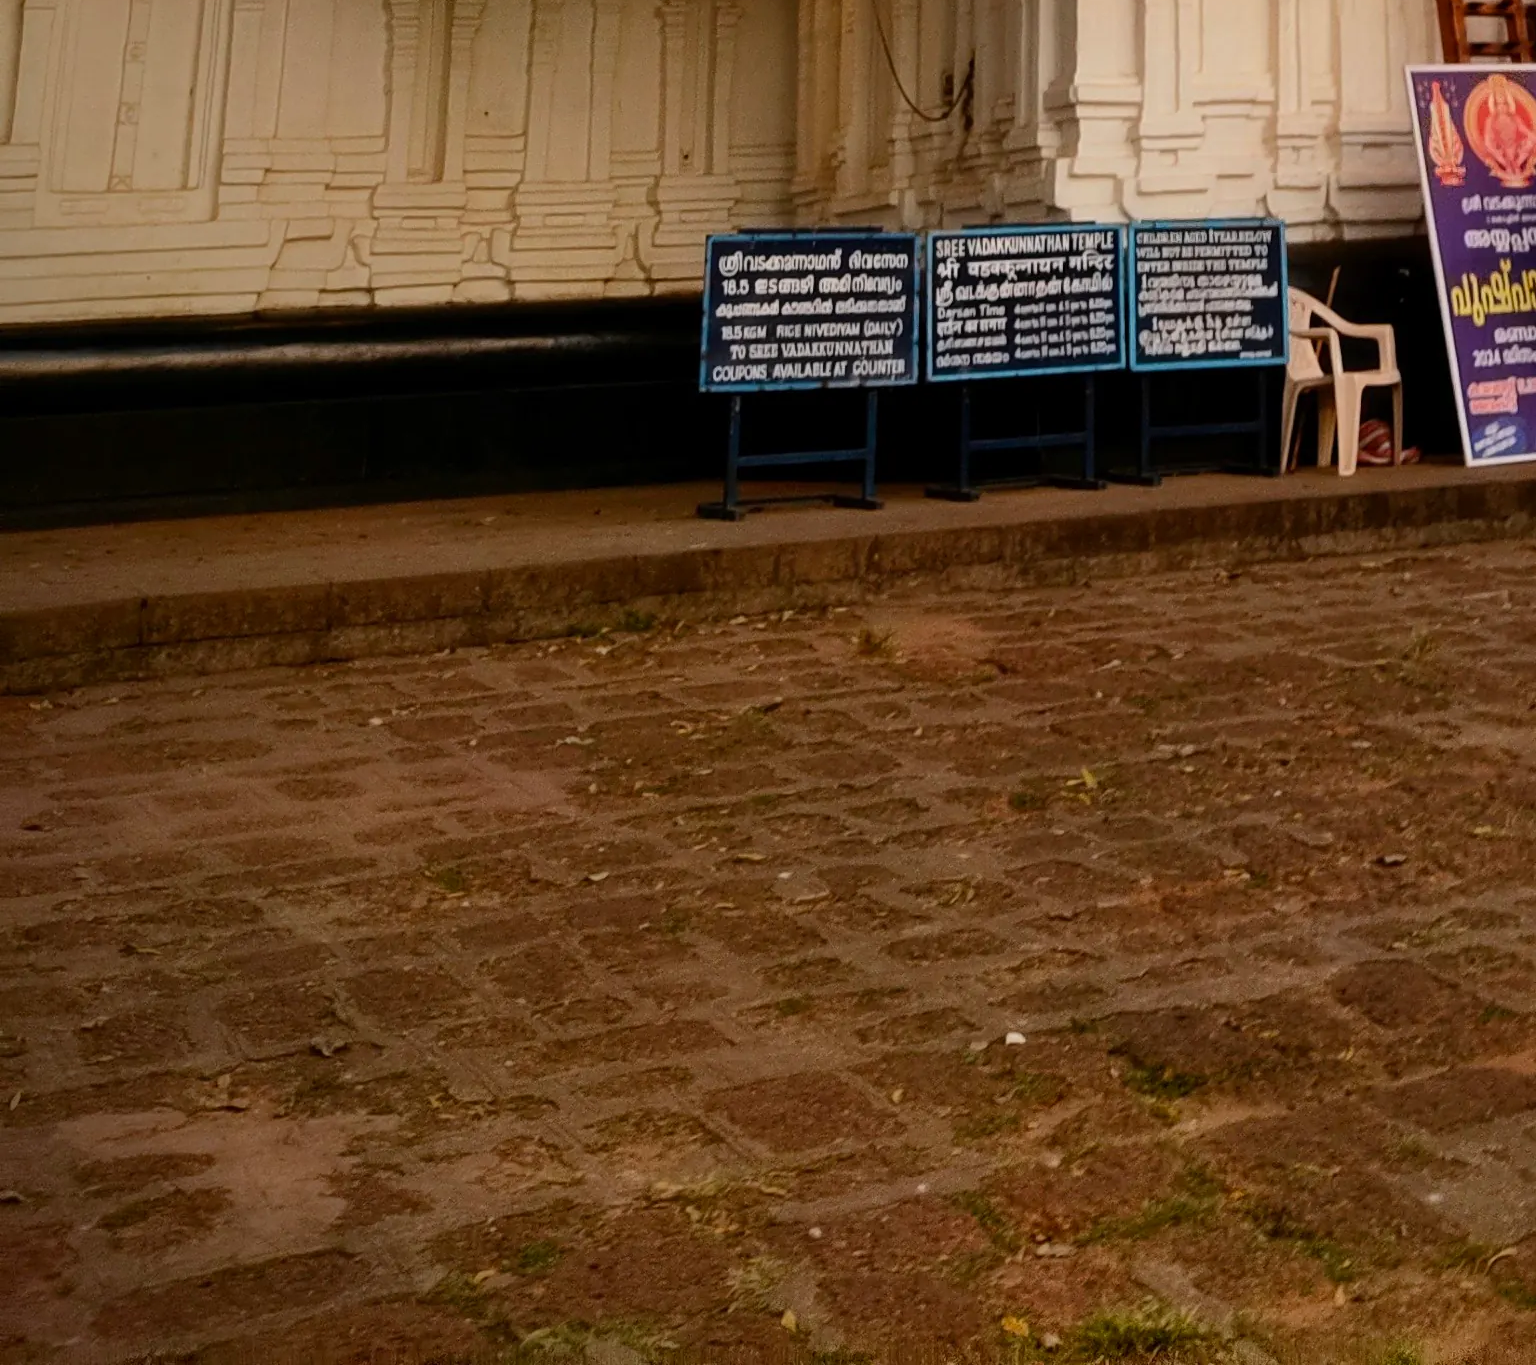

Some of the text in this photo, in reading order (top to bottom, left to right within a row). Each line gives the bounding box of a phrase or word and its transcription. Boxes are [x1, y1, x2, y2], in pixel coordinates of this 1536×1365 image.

[936, 232, 1114, 258] SREE VADAKKUNNATHAN TEMPLE
[1194, 245, 1251, 257] PERMITTED
[1254, 245, 1268, 256] TO
[721, 278, 749, 296] 18.5
[979, 304, 1006, 317] Time
[776, 323, 800, 339] RICE
[804, 322, 860, 338] NIVEDIYAM
[863, 318, 904, 337] (DAILY)
[730, 344, 746, 360] TO
[781, 340, 894, 359] VADAKKUNNATHAN
[713, 359, 905, 382] COUPONS AVAILABLE AT COUNTER
